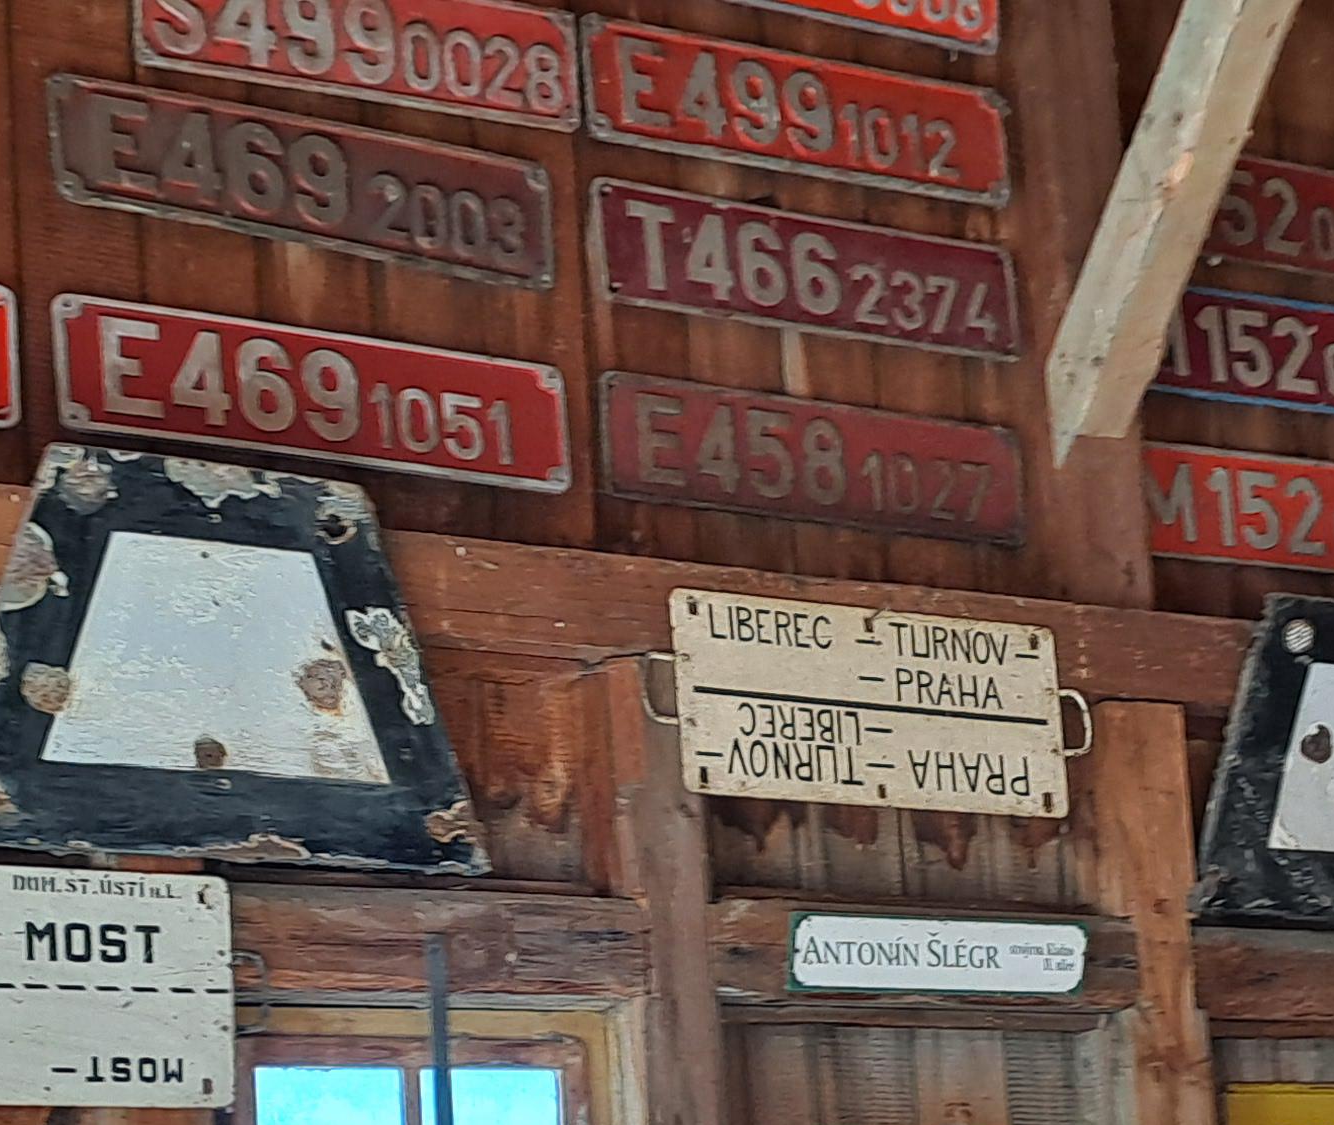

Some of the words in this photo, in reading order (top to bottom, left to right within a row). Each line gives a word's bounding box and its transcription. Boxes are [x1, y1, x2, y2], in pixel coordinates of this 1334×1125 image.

[402, 22, 563, 113] 0028
[617, 36, 835, 153] E499
[839, 102, 960, 181] 1012
[85, 98, 350, 226] E469
[1215, 169, 1305, 256] 52
[625, 199, 843, 316] T466
[848, 262, 1000, 343] 2374
[96, 315, 362, 442] E469
[370, 381, 515, 466] 1051
[633, 395, 848, 505] E458
[860, 451, 993, 523] 1027
[1148, 462, 1327, 557] M152
[707, 603, 834, 650] LIBEREC
[888, 621, 1009, 667] TURNOV
[738, 702, 864, 747] LIBEREC
[895, 668, 1004, 711] PRAHA
[727, 737, 865, 786] TURNOV
[907, 749, 1032, 798] PRAHA
[23, 920, 162, 965] MOST
